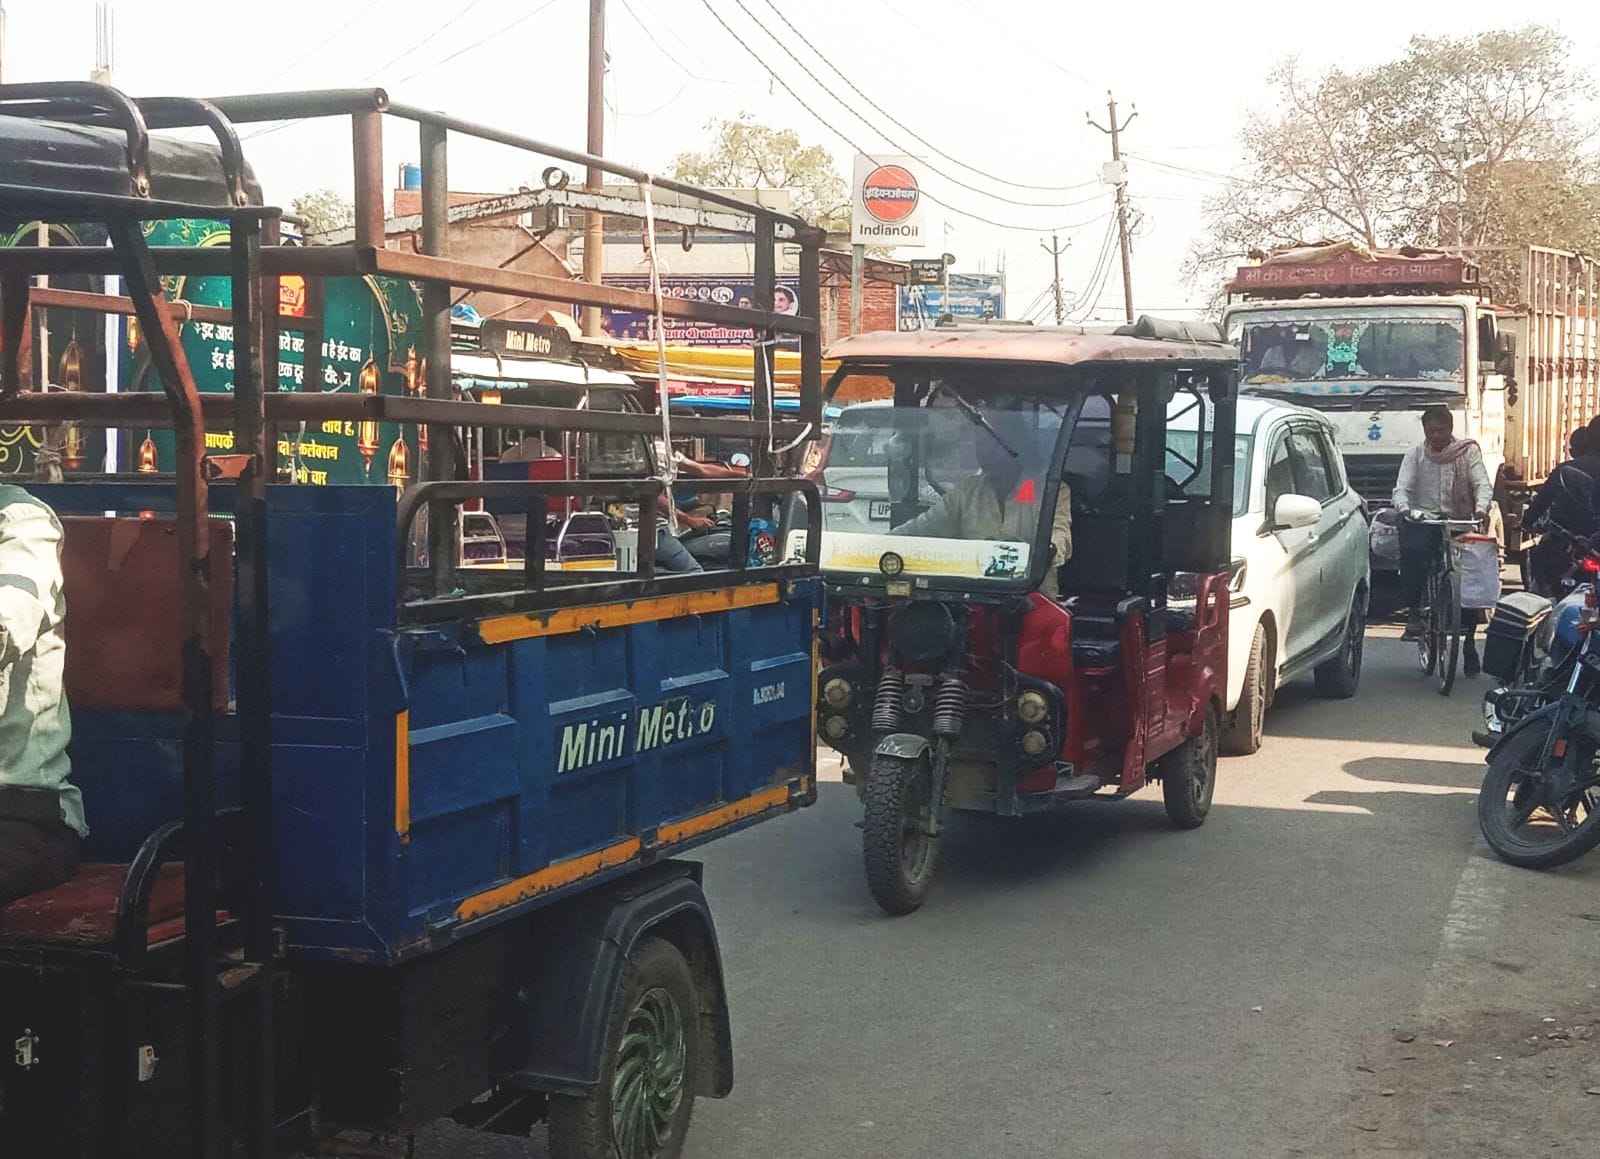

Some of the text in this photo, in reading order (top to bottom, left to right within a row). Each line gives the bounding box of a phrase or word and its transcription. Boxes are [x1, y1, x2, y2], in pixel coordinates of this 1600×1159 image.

[859, 224, 919, 237] IndianOil
[506, 330, 551, 354] Mini Metro
[557, 713, 627, 773] Mini
